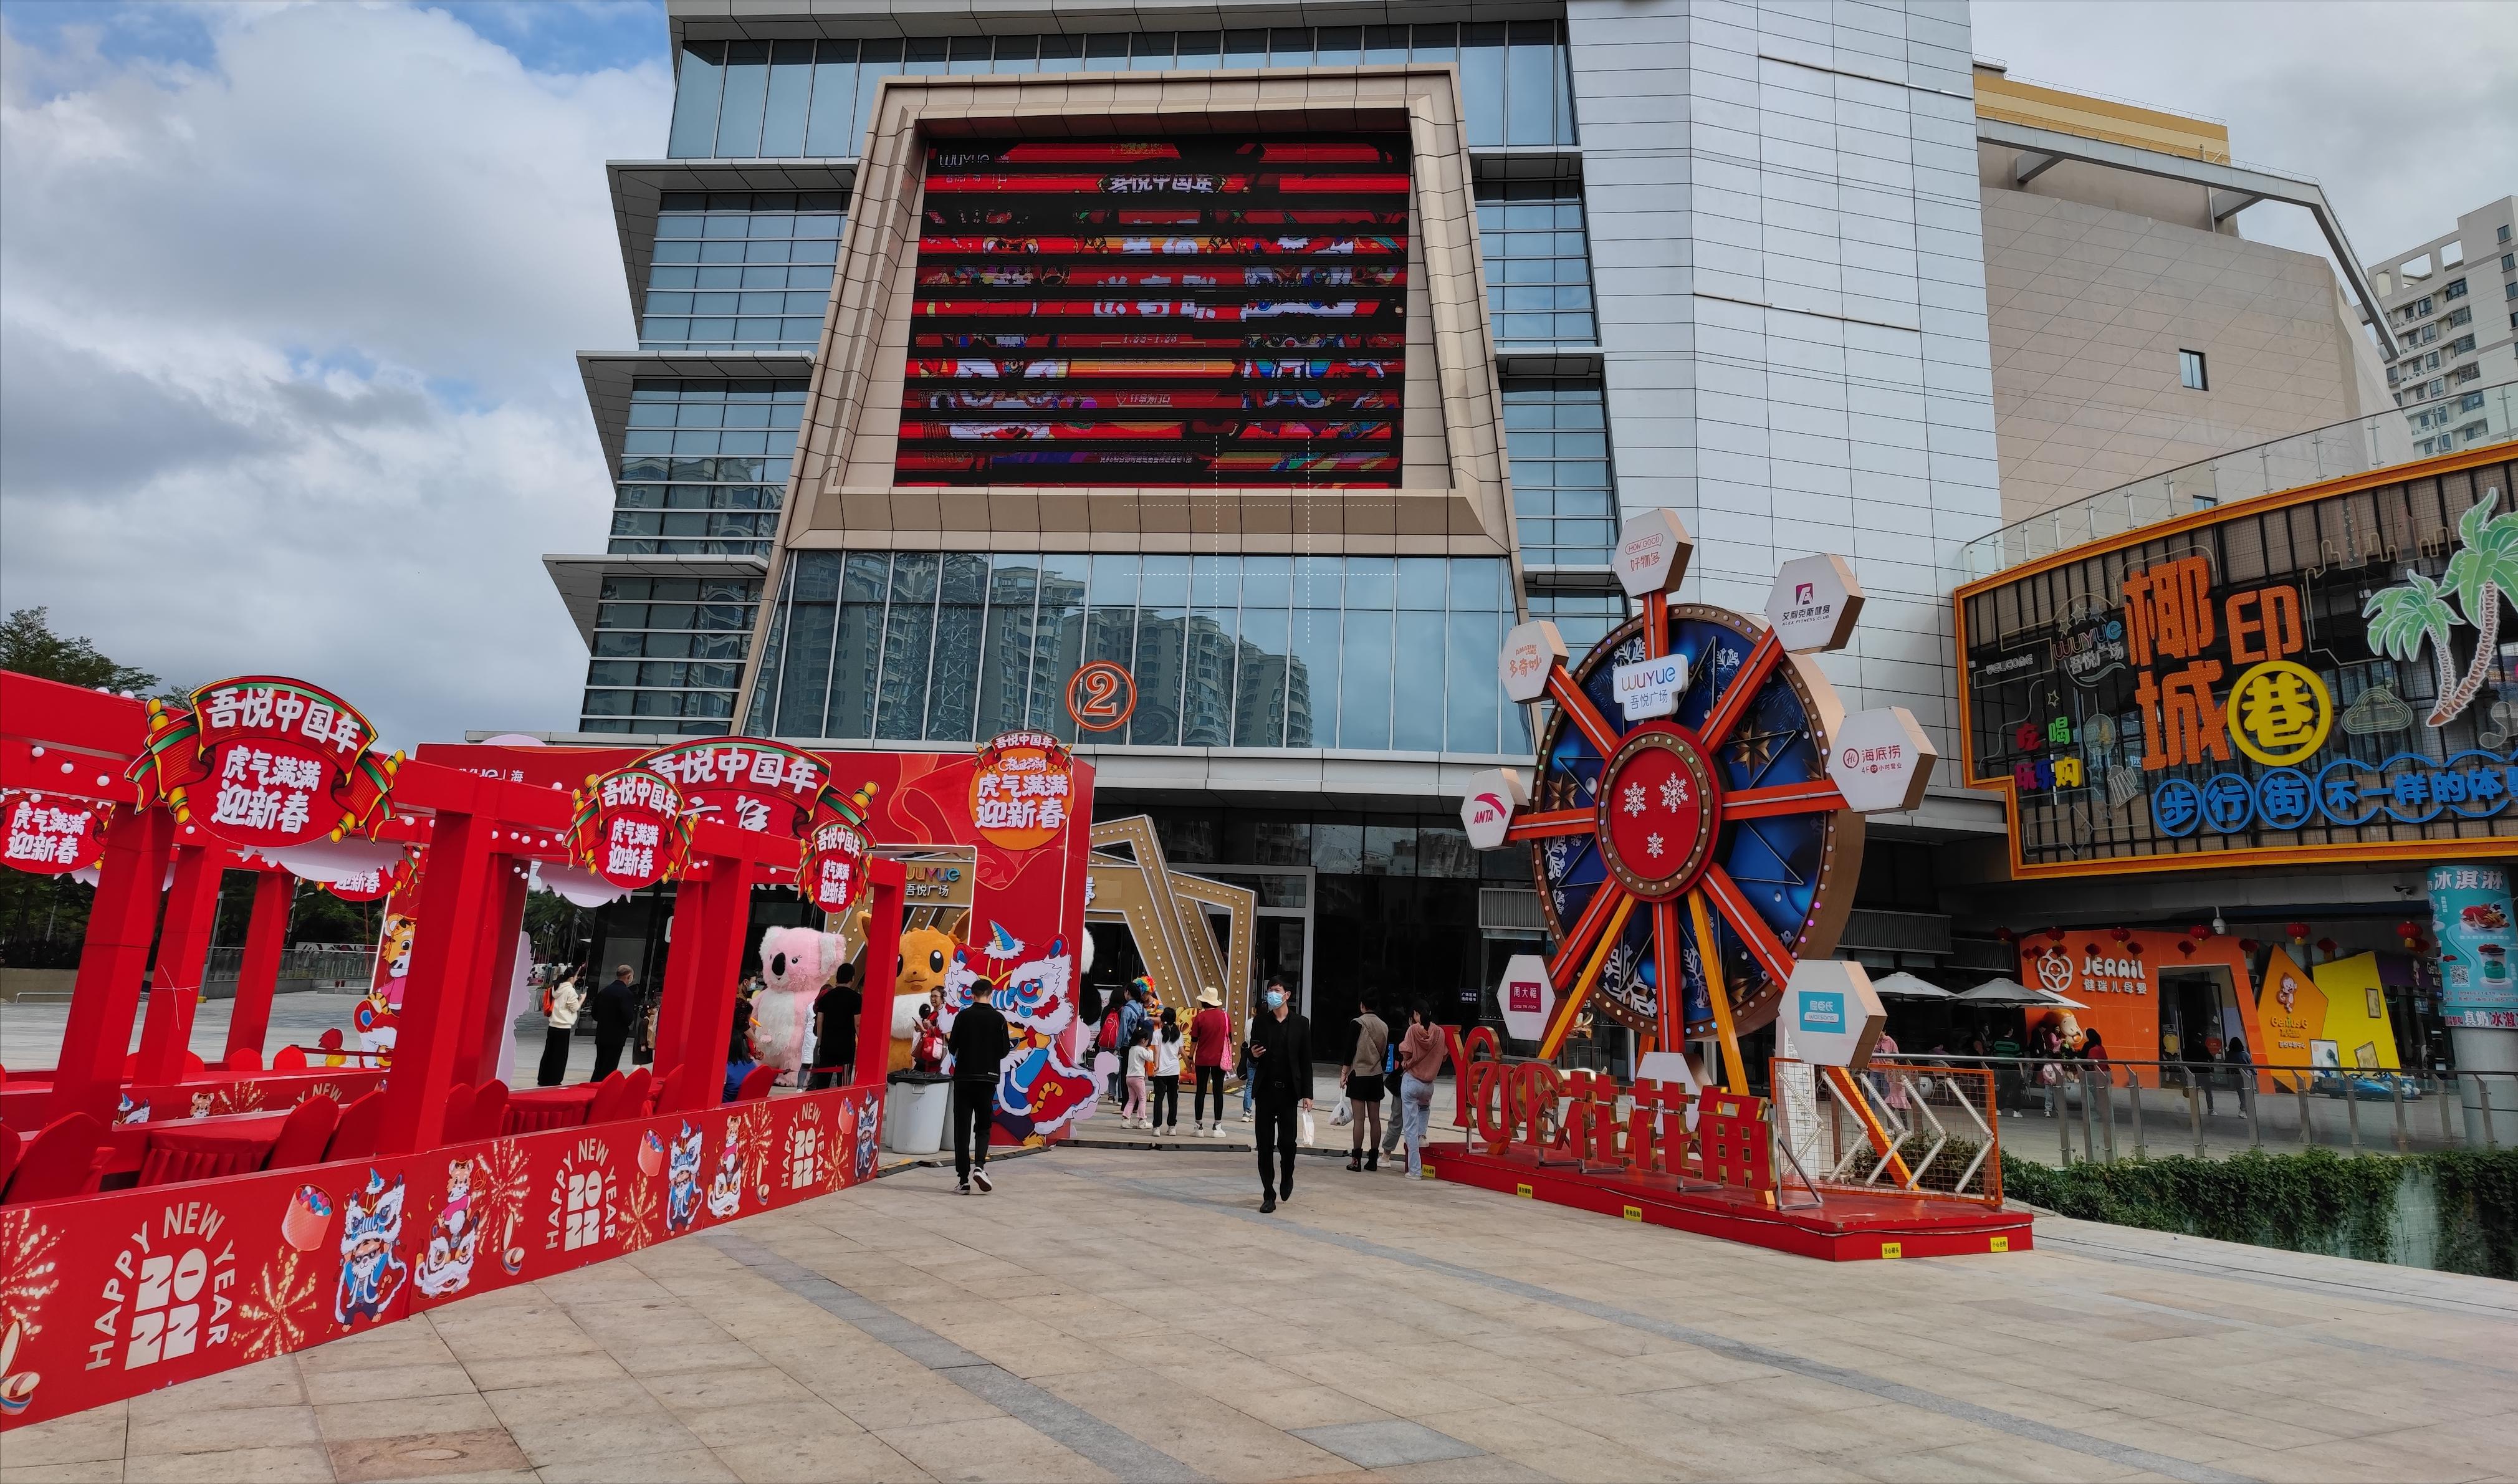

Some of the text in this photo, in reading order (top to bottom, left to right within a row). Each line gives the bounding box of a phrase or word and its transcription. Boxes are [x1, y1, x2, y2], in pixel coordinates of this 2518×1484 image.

[1629, 536, 1660, 552] HOW GOOD
[1630, 552, 1660, 572] 好物多
[1510, 655, 1542, 678] 多奇妙
[2069, 641, 2124, 675] 吾悦广场
[1630, 689, 1668, 710] 吾悦广场
[206, 687, 360, 754] 吾悦中国年
[995, 733, 1053, 749] 吾悦中国年
[1861, 745, 1900, 763] 海底捞
[222, 744, 322, 792] 虎气满满
[648, 747, 818, 793] 吾悦中国年
[601, 775, 677, 819] 吾悦中国年
[977, 773, 1068, 798] 虎气满满
[11, 807, 86, 836] 虎气满满
[211, 779, 310, 834] 迎新春
[974, 797, 1066, 829] 迎新春
[1473, 809, 1493, 824] ANTA
[4, 828, 79, 864] 迎新春
[611, 817, 659, 847] 虎气满满
[817, 826, 862, 858] 吾悦中国年
[606, 842, 654, 878] 迎新春
[822, 859, 850, 881] 虎气满满
[819, 878, 847, 904] 迎新春
[906, 883, 949, 897] 吾悦广场
[1513, 987, 1537, 998] 周大福
[2084, 979, 2148, 995] 健瑞儿母婴
[2464, 1010, 2518, 1027] 真奶冰激
[780, 1102, 824, 1187] HAPPY NEW YEAR
[793, 1127, 816, 1160] 20
[545, 1138, 618, 1250] HAPPY NEW YEAR
[567, 1170, 603, 1212] 20
[564, 1210, 600, 1252] 22
[85, 1202, 236, 1372] HAPPY NEW YEAR
[135, 1248, 208, 1313] 20
[125, 1307, 202, 1371] 22
